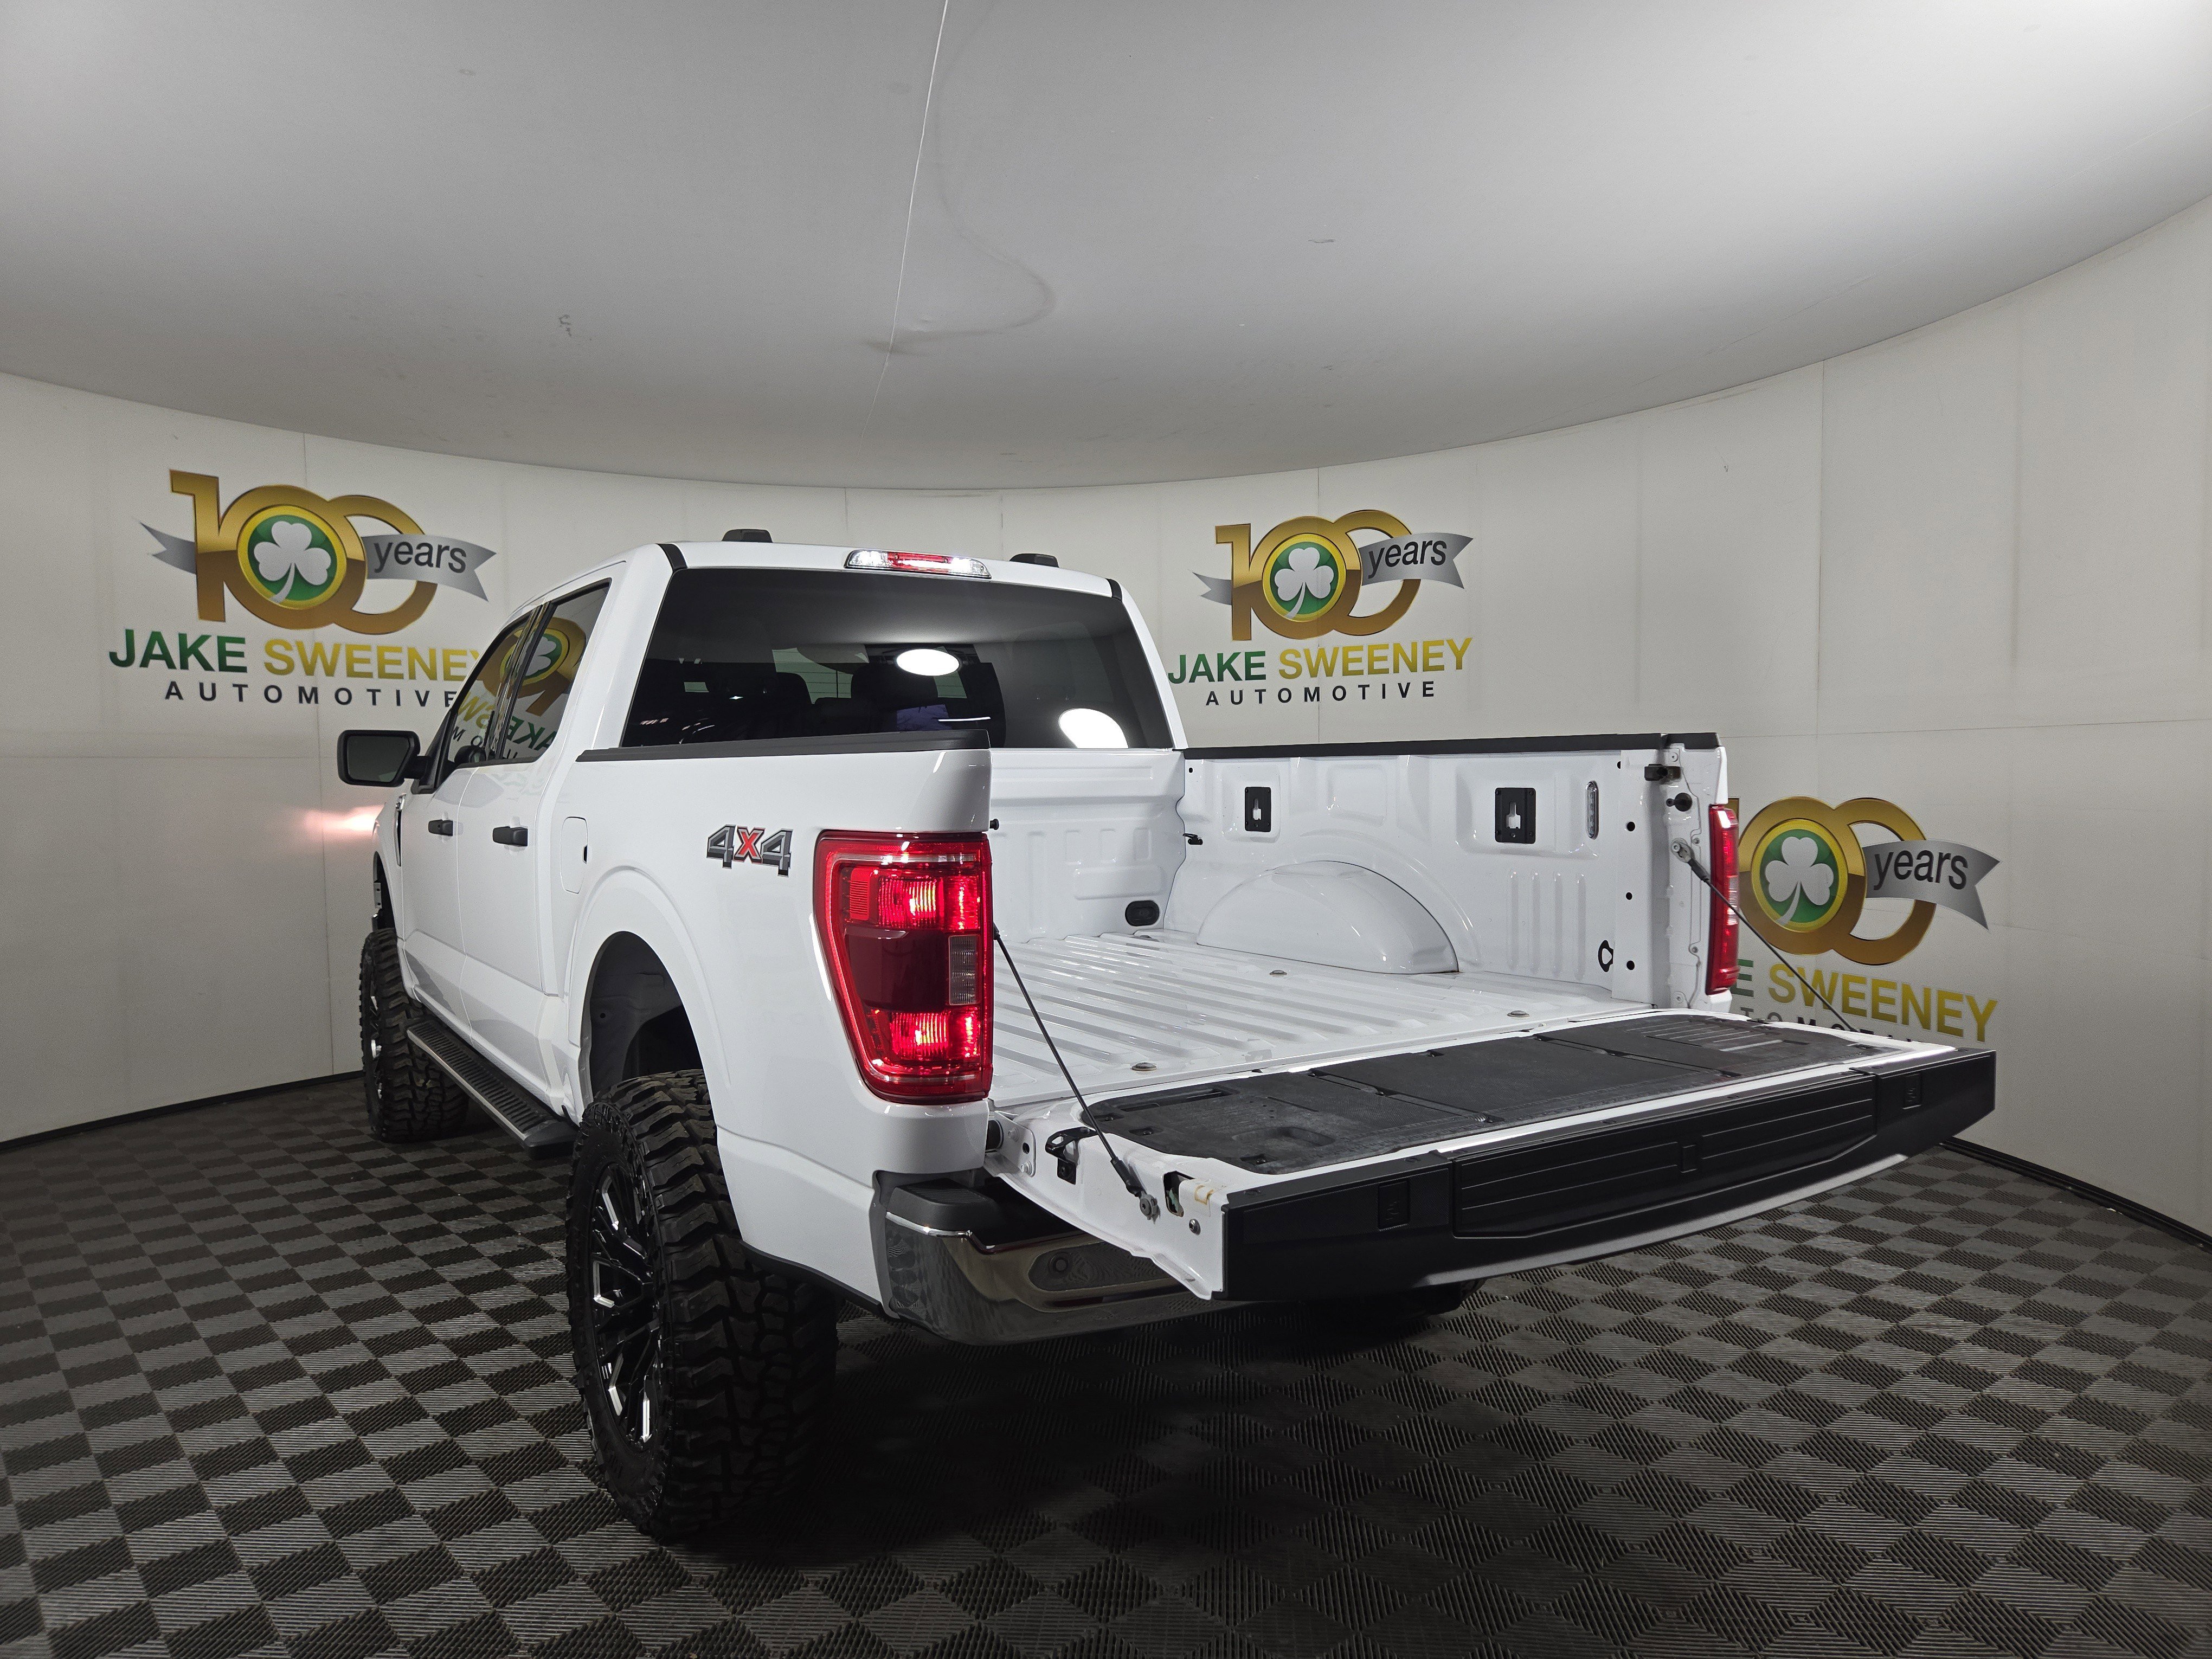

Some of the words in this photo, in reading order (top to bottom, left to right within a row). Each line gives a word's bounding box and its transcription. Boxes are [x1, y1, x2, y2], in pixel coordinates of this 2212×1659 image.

[169, 469, 438, 635] 100
[373, 538, 468, 573] years
[1214, 509, 1422, 641] 100
[1368, 539, 1448, 579] years
[109, 629, 248, 673] JAKE
[263, 639, 480, 682] SWEENE
[1168, 650, 1266, 684] JAKE
[1278, 637, 1474, 679] SWEENEY
[164, 680, 457, 708] AUTOMOTIVE
[1205, 680, 1435, 706] AUTOMOTIVE
[1874, 849, 1969, 891] years
[1768, 963, 1998, 1043] SWEENEY
